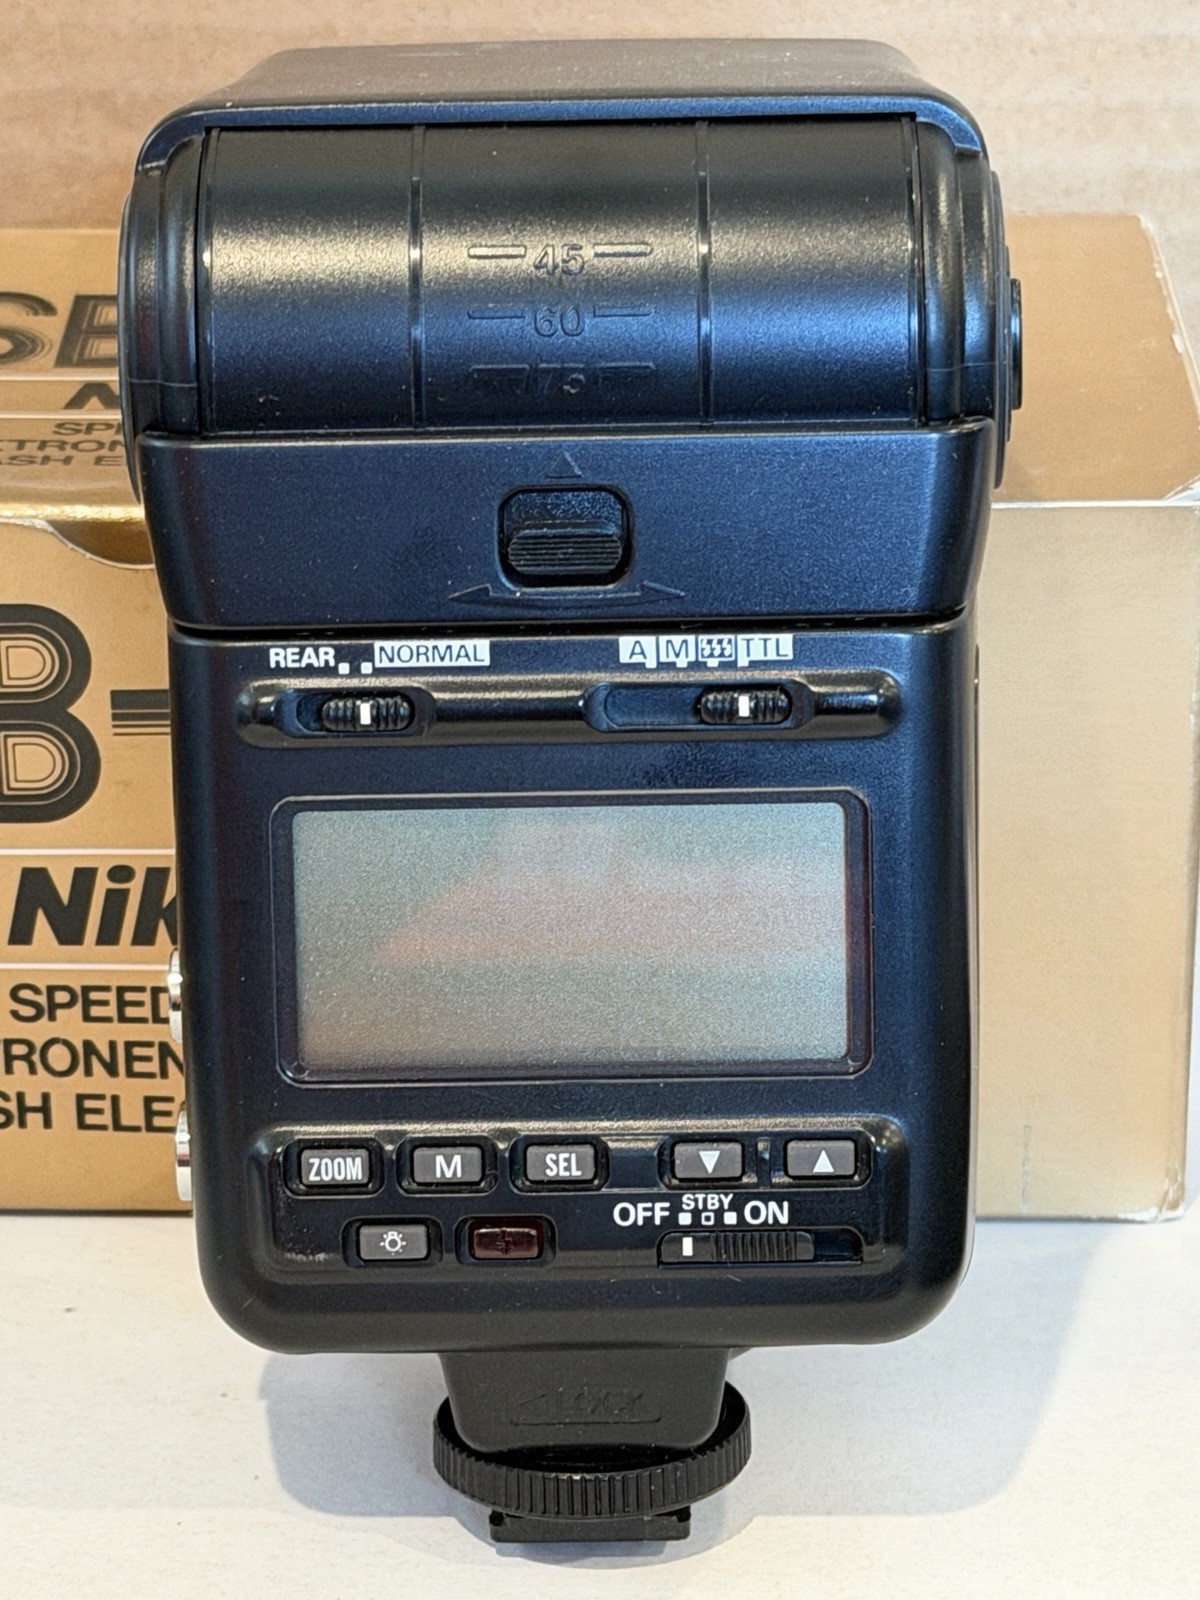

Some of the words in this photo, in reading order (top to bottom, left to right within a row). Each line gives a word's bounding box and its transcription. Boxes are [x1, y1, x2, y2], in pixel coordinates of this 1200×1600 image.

[533, 243, 586, 276] 45
[533, 305, 586, 338] 60
[269, 647, 335, 669] REAR
[378, 643, 486, 664] NORMAL
[626, 638, 650, 661] A
[664, 638, 691, 660] M
[740, 636, 790, 659] TTL
[308, 1156, 363, 1181] ZOOM
[435, 1154, 463, 1178] M
[545, 1152, 583, 1177] SEL
[613, 1202, 671, 1227] OFF
[682, 1193, 734, 1211] STBY
[744, 1200, 790, 1226] ON
